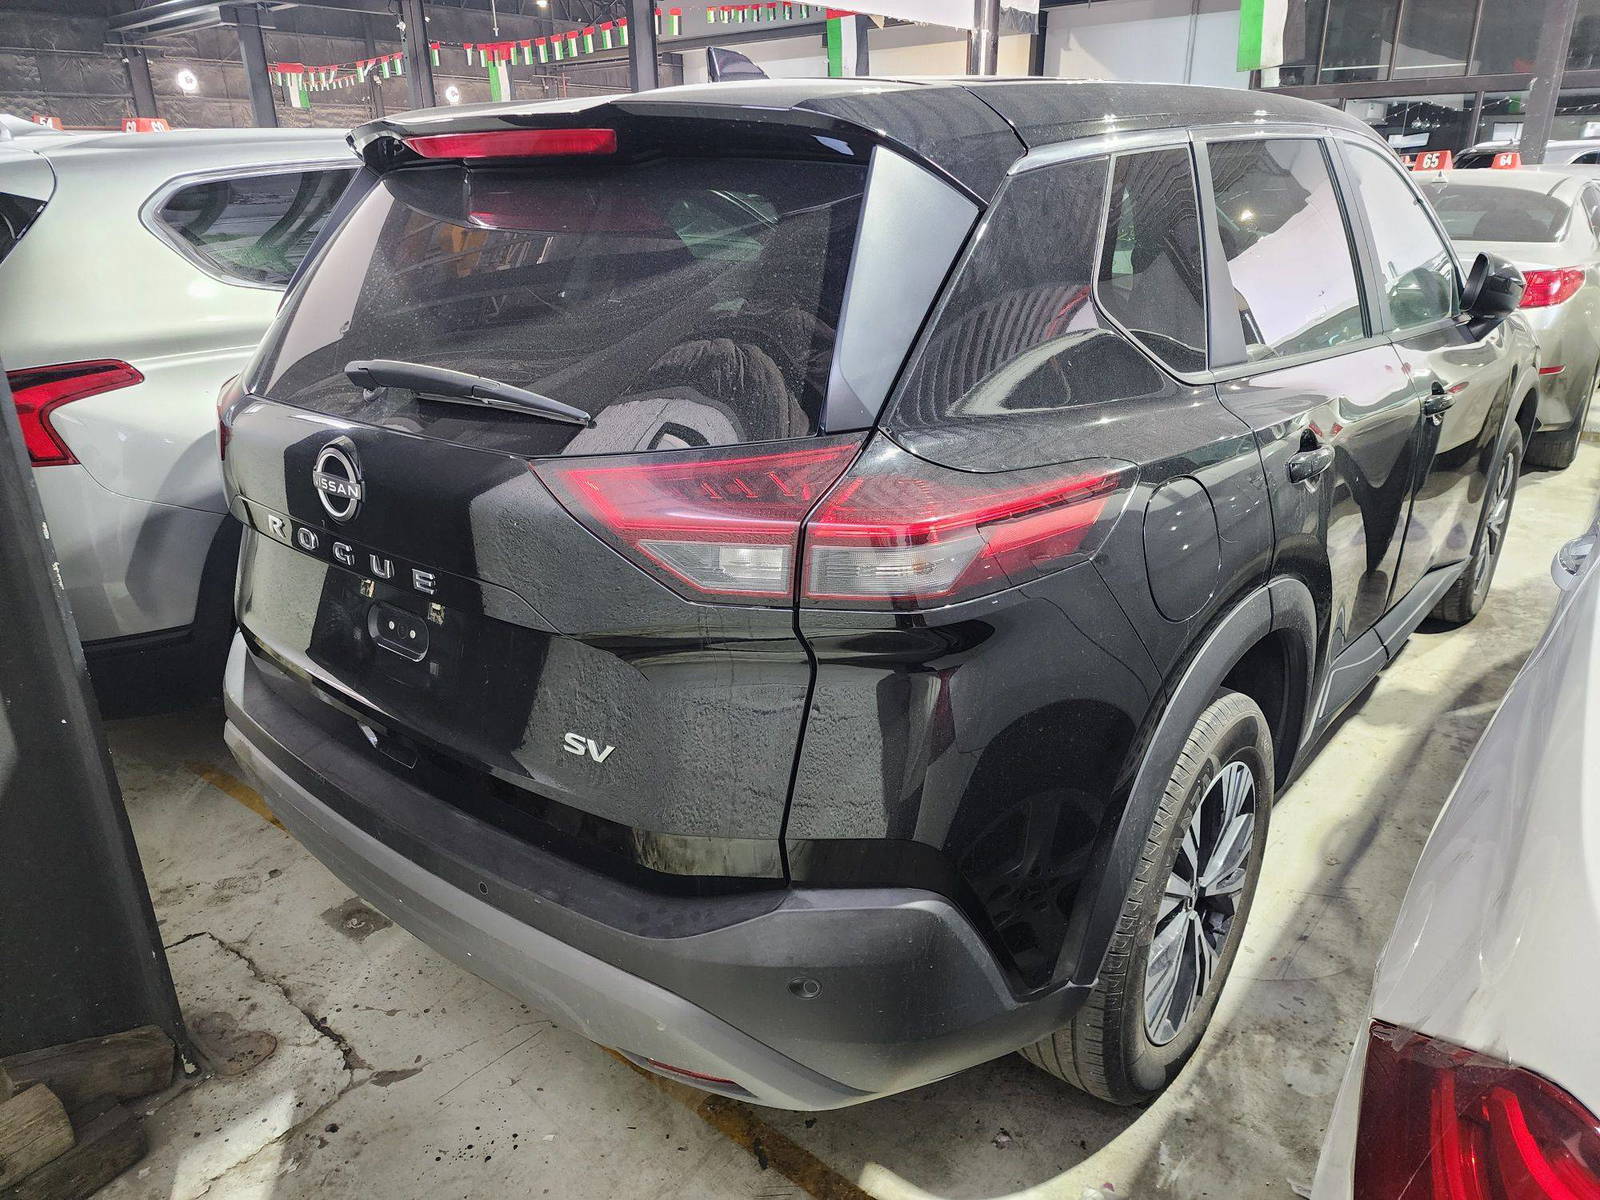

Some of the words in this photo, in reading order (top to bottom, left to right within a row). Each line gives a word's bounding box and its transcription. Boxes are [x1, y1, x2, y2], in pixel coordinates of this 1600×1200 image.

[1422, 152, 1440, 169] 65
[1499, 155, 1513, 166] 64
[268, 514, 438, 595] ROGUE
[563, 732, 616, 763] SV
